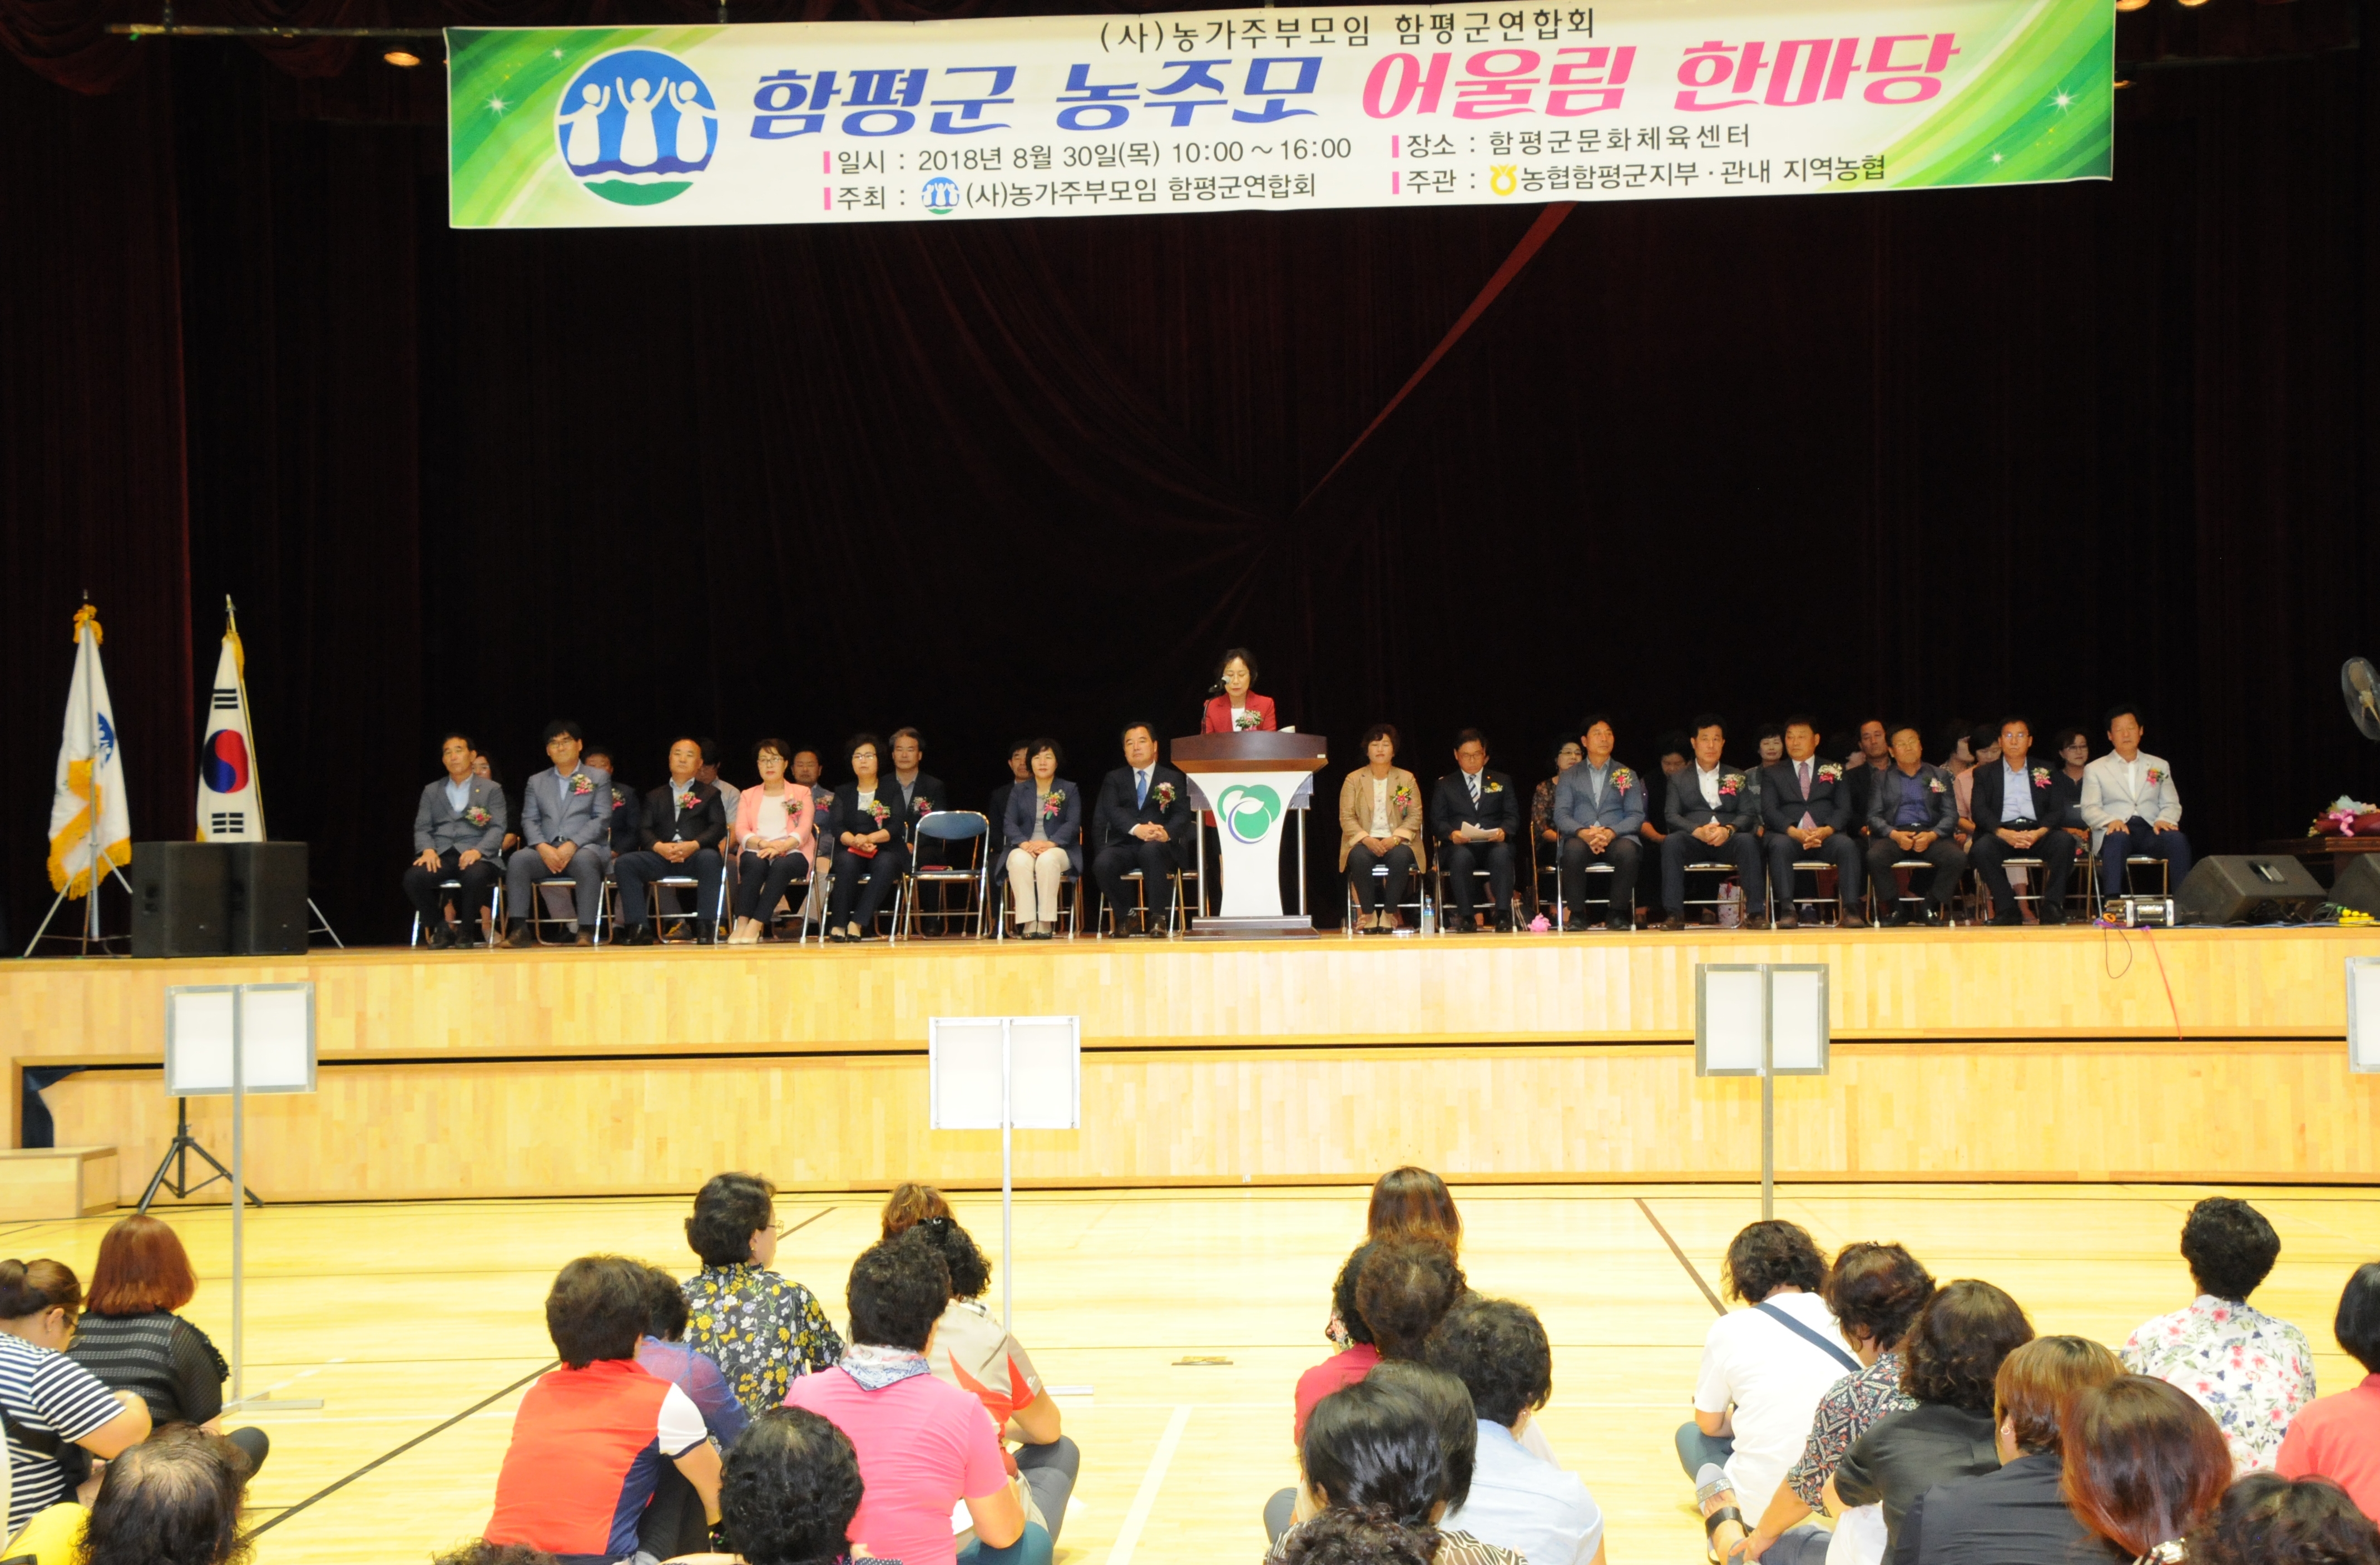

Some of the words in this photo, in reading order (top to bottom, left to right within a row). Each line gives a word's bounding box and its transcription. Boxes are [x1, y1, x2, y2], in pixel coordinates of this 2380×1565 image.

[1100, 17, 1369, 53] (사)농가주부모임
[1393, 7, 1594, 45] 함평군연합회
[750, 66, 1017, 140] 함평군
[1056, 56, 1323, 131] 농주모
[1361, 45, 1637, 120] 어울림
[1674, 33, 1961, 112] 한마당
[838, 150, 884, 175] 일시
[919, 147, 1001, 171] 2018년
[1013, 145, 1051, 170] 8월
[1063, 141, 1160, 168] 30일(목)
[1407, 134, 1456, 158] 장소
[1490, 124, 1749, 155] 함평군문화체육센터
[837, 186, 885, 210] 주최
[967, 178, 1156, 209] (사)농가주부모임
[1168, 173, 1314, 201] 함평군연합회
[1407, 169, 1457, 194] 주관
[1784, 155, 1884, 182] 지역농협
